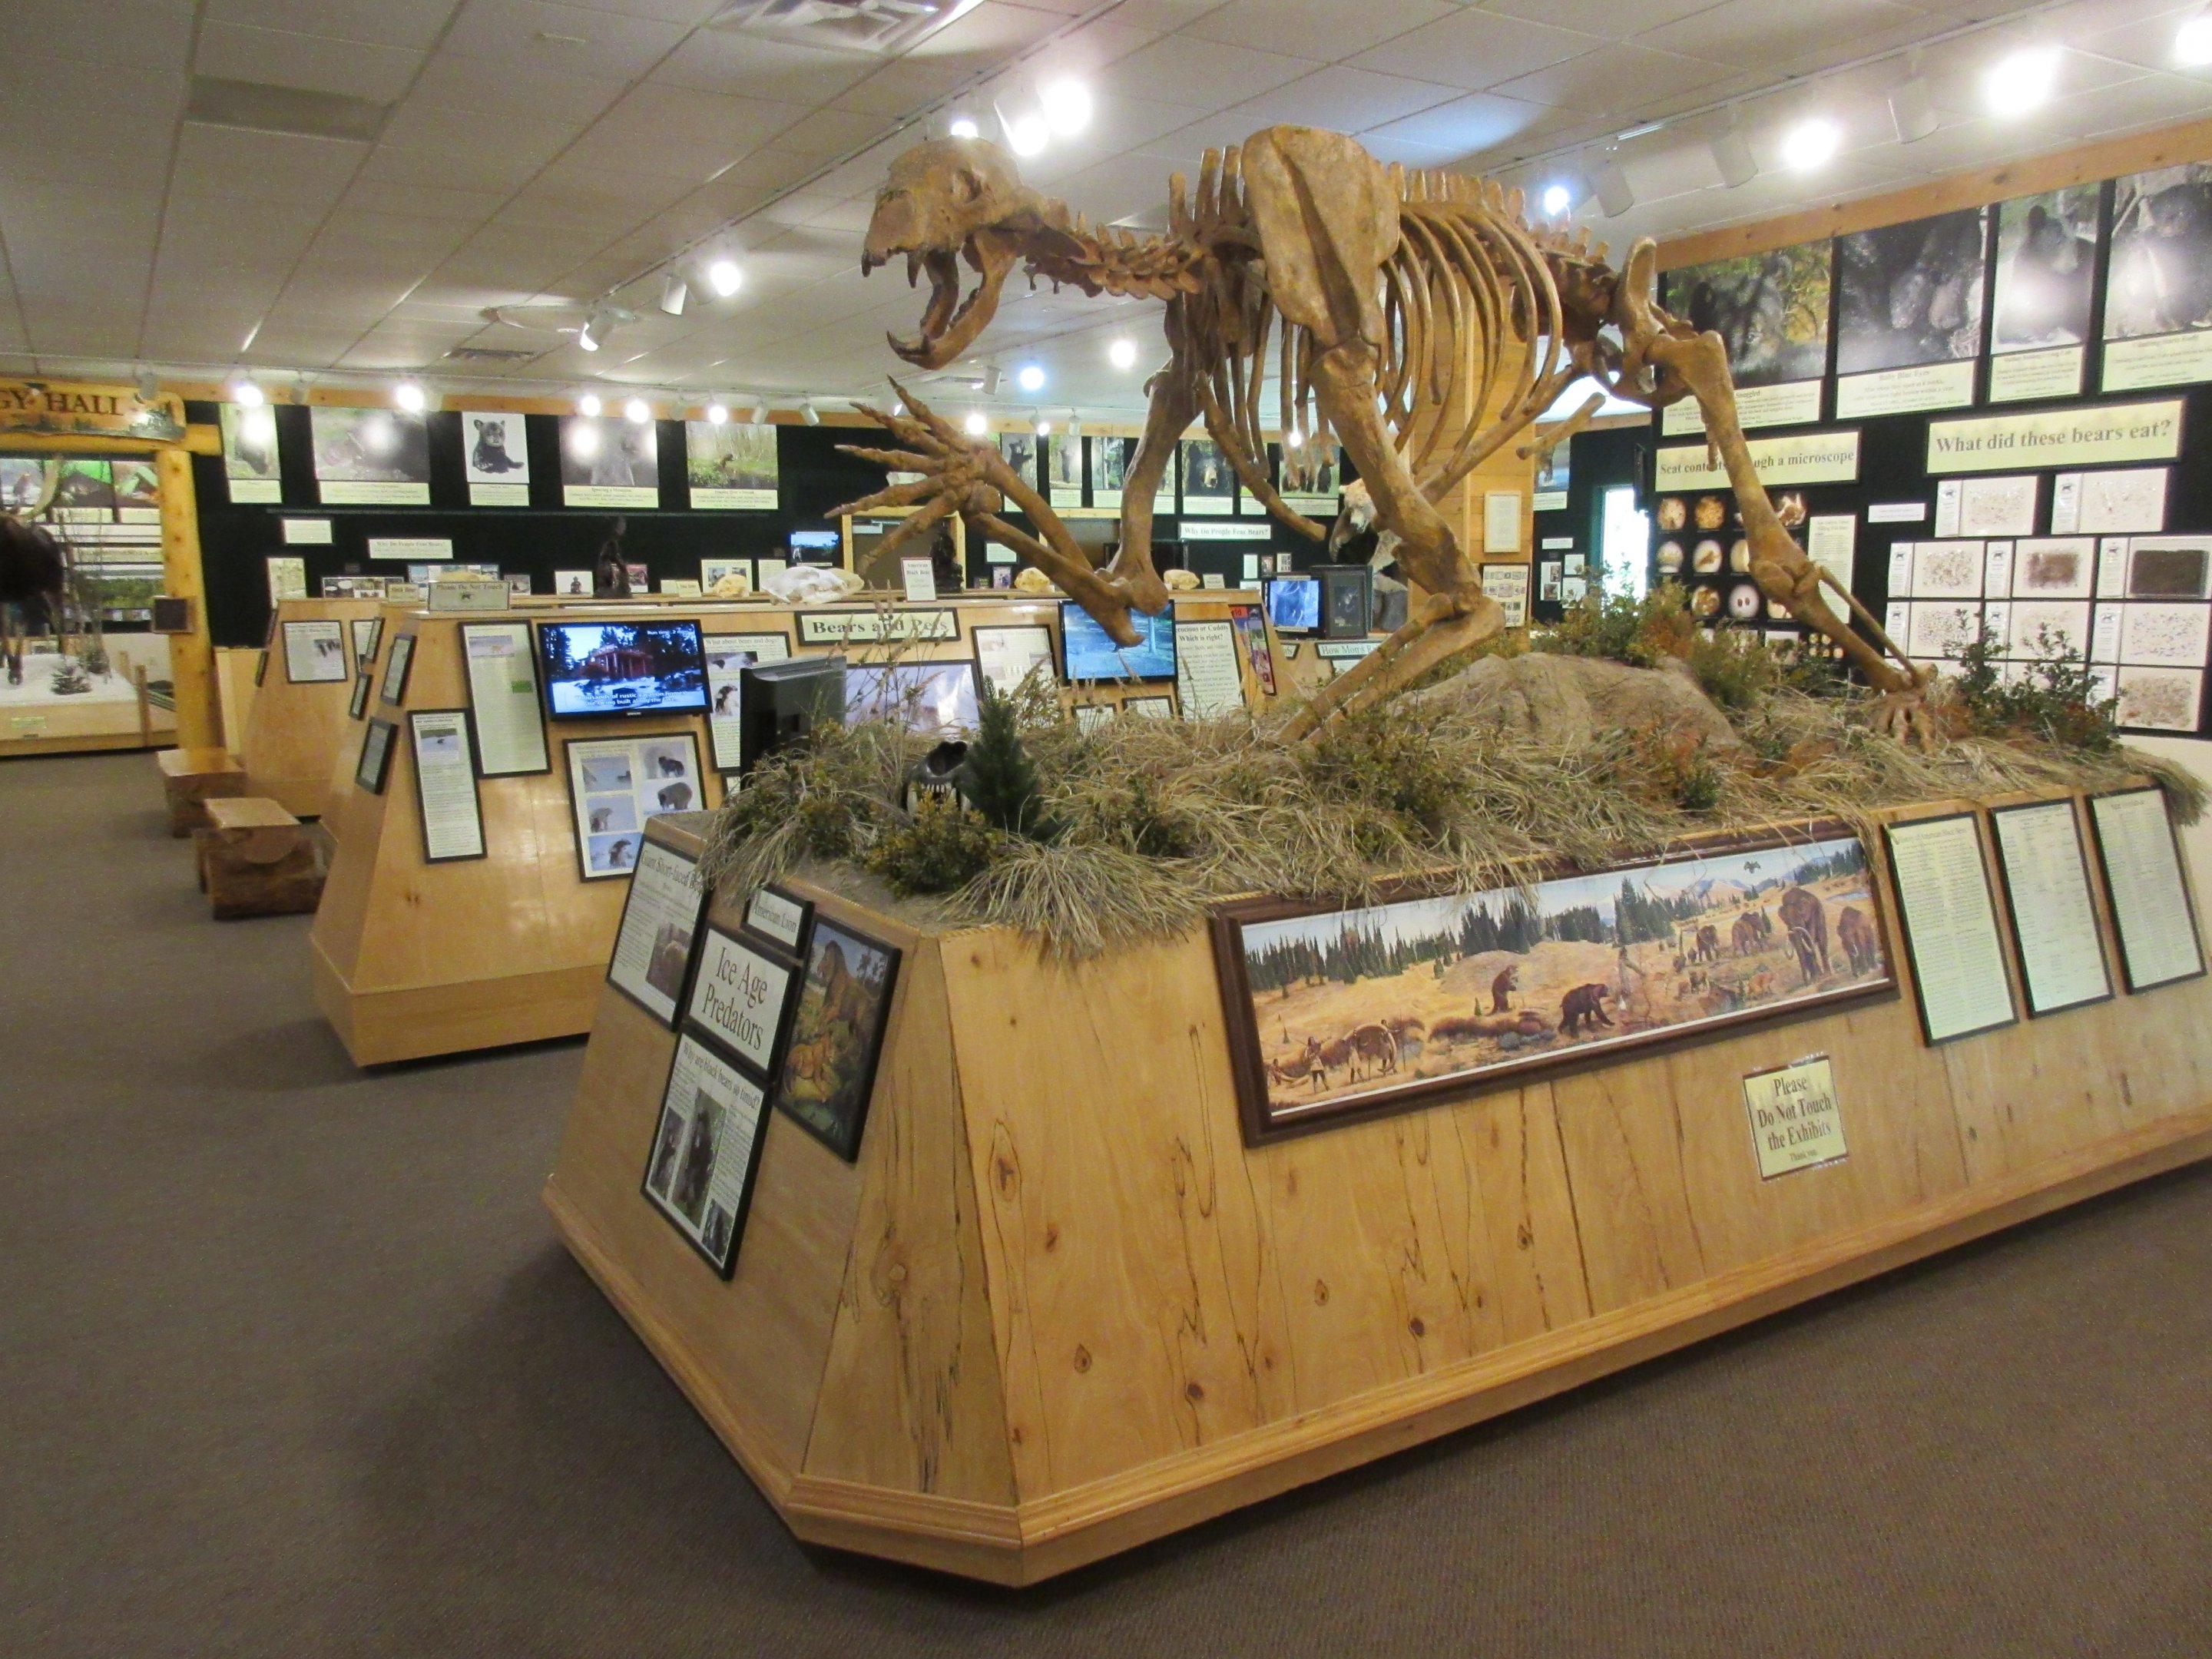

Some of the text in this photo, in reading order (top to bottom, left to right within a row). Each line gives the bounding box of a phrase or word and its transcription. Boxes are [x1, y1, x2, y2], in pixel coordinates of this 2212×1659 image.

[45, 392, 124, 416] HALL
[1936, 419, 2173, 452] What did these bears eat?
[1660, 463, 1682, 474] Scat
[1777, 458, 1783, 466] a
[1787, 451, 1854, 466] microscope
[1184, 527, 1198, 536] Why
[1211, 528, 1230, 536] People
[812, 621, 866, 634] Bears
[872, 618, 904, 632] and
[1321, 645, 1339, 655] How
[780, 912, 797, 933] Lion
[716, 946, 767, 1009] Ice Age
[701, 982, 764, 1051] Predators
[1773, 1076, 1808, 1097] Please
[1757, 1092, 1833, 1128] Do Not Touch
[1767, 1119, 1833, 1151] the Exhibits
